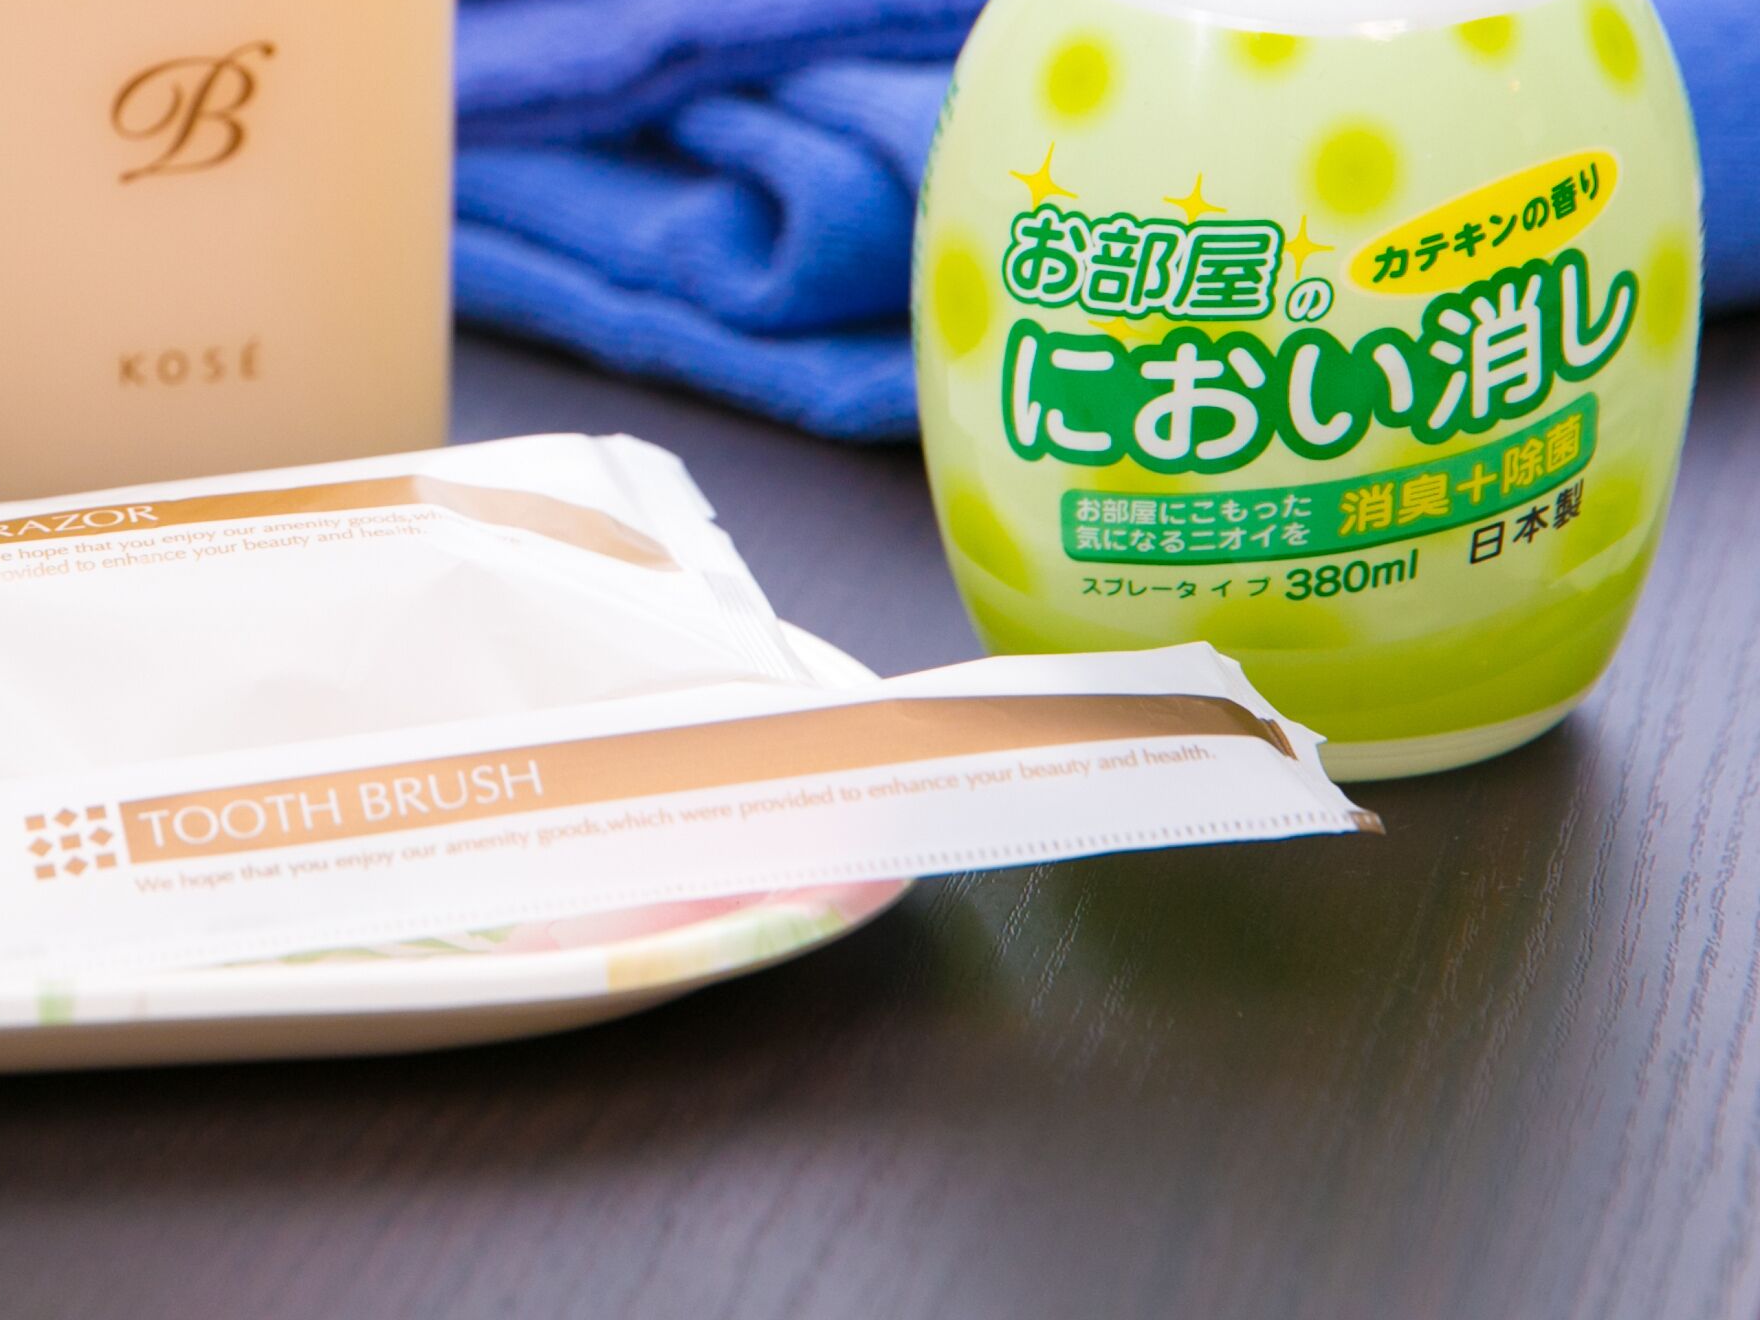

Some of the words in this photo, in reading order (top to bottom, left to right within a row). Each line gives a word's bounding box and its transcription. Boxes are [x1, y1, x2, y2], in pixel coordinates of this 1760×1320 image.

[110, 39, 278, 185] B
[1372, 162, 1600, 283] カテキンの香り
[1002, 248, 1639, 475] におい消し
[18, 545, 69, 562] hope
[75, 540, 113, 555] that
[118, 537, 156, 553] you
[162, 529, 217, 547] enjoy
[222, 526, 256, 538] our
[262, 516, 343, 536] amenity
[76, 557, 96, 571] to
[102, 549, 188, 570] enhance
[192, 544, 243, 562] your
[244, 535, 311, 555] beauty
[318, 528, 354, 543] and
[1076, 494, 1312, 526] お部屋にこもった
[1076, 522, 1310, 553] 気になるニオイを
[1469, 477, 1585, 565] 日本製
[1285, 548, 1419, 601] 380ml
[134, 878, 174, 894] We
[179, 870, 235, 890] hope
[240, 860, 282, 880] that
[286, 857, 330, 876] you
[335, 847, 395, 870] enjoy
[401, 844, 437, 860] our
[445, 826, 531, 855] amenity
[680, 800, 732, 822] were
[739, 783, 836, 820] provided
[839, 781, 862, 803] to
[868, 771, 960, 801] enhance
[965, 768, 1014, 792] your
[1019, 756, 1091, 781] beauty
[1098, 749, 1139, 771] and
[138, 787, 343, 848] TOOTH
[358, 759, 544, 823] BRUSH
